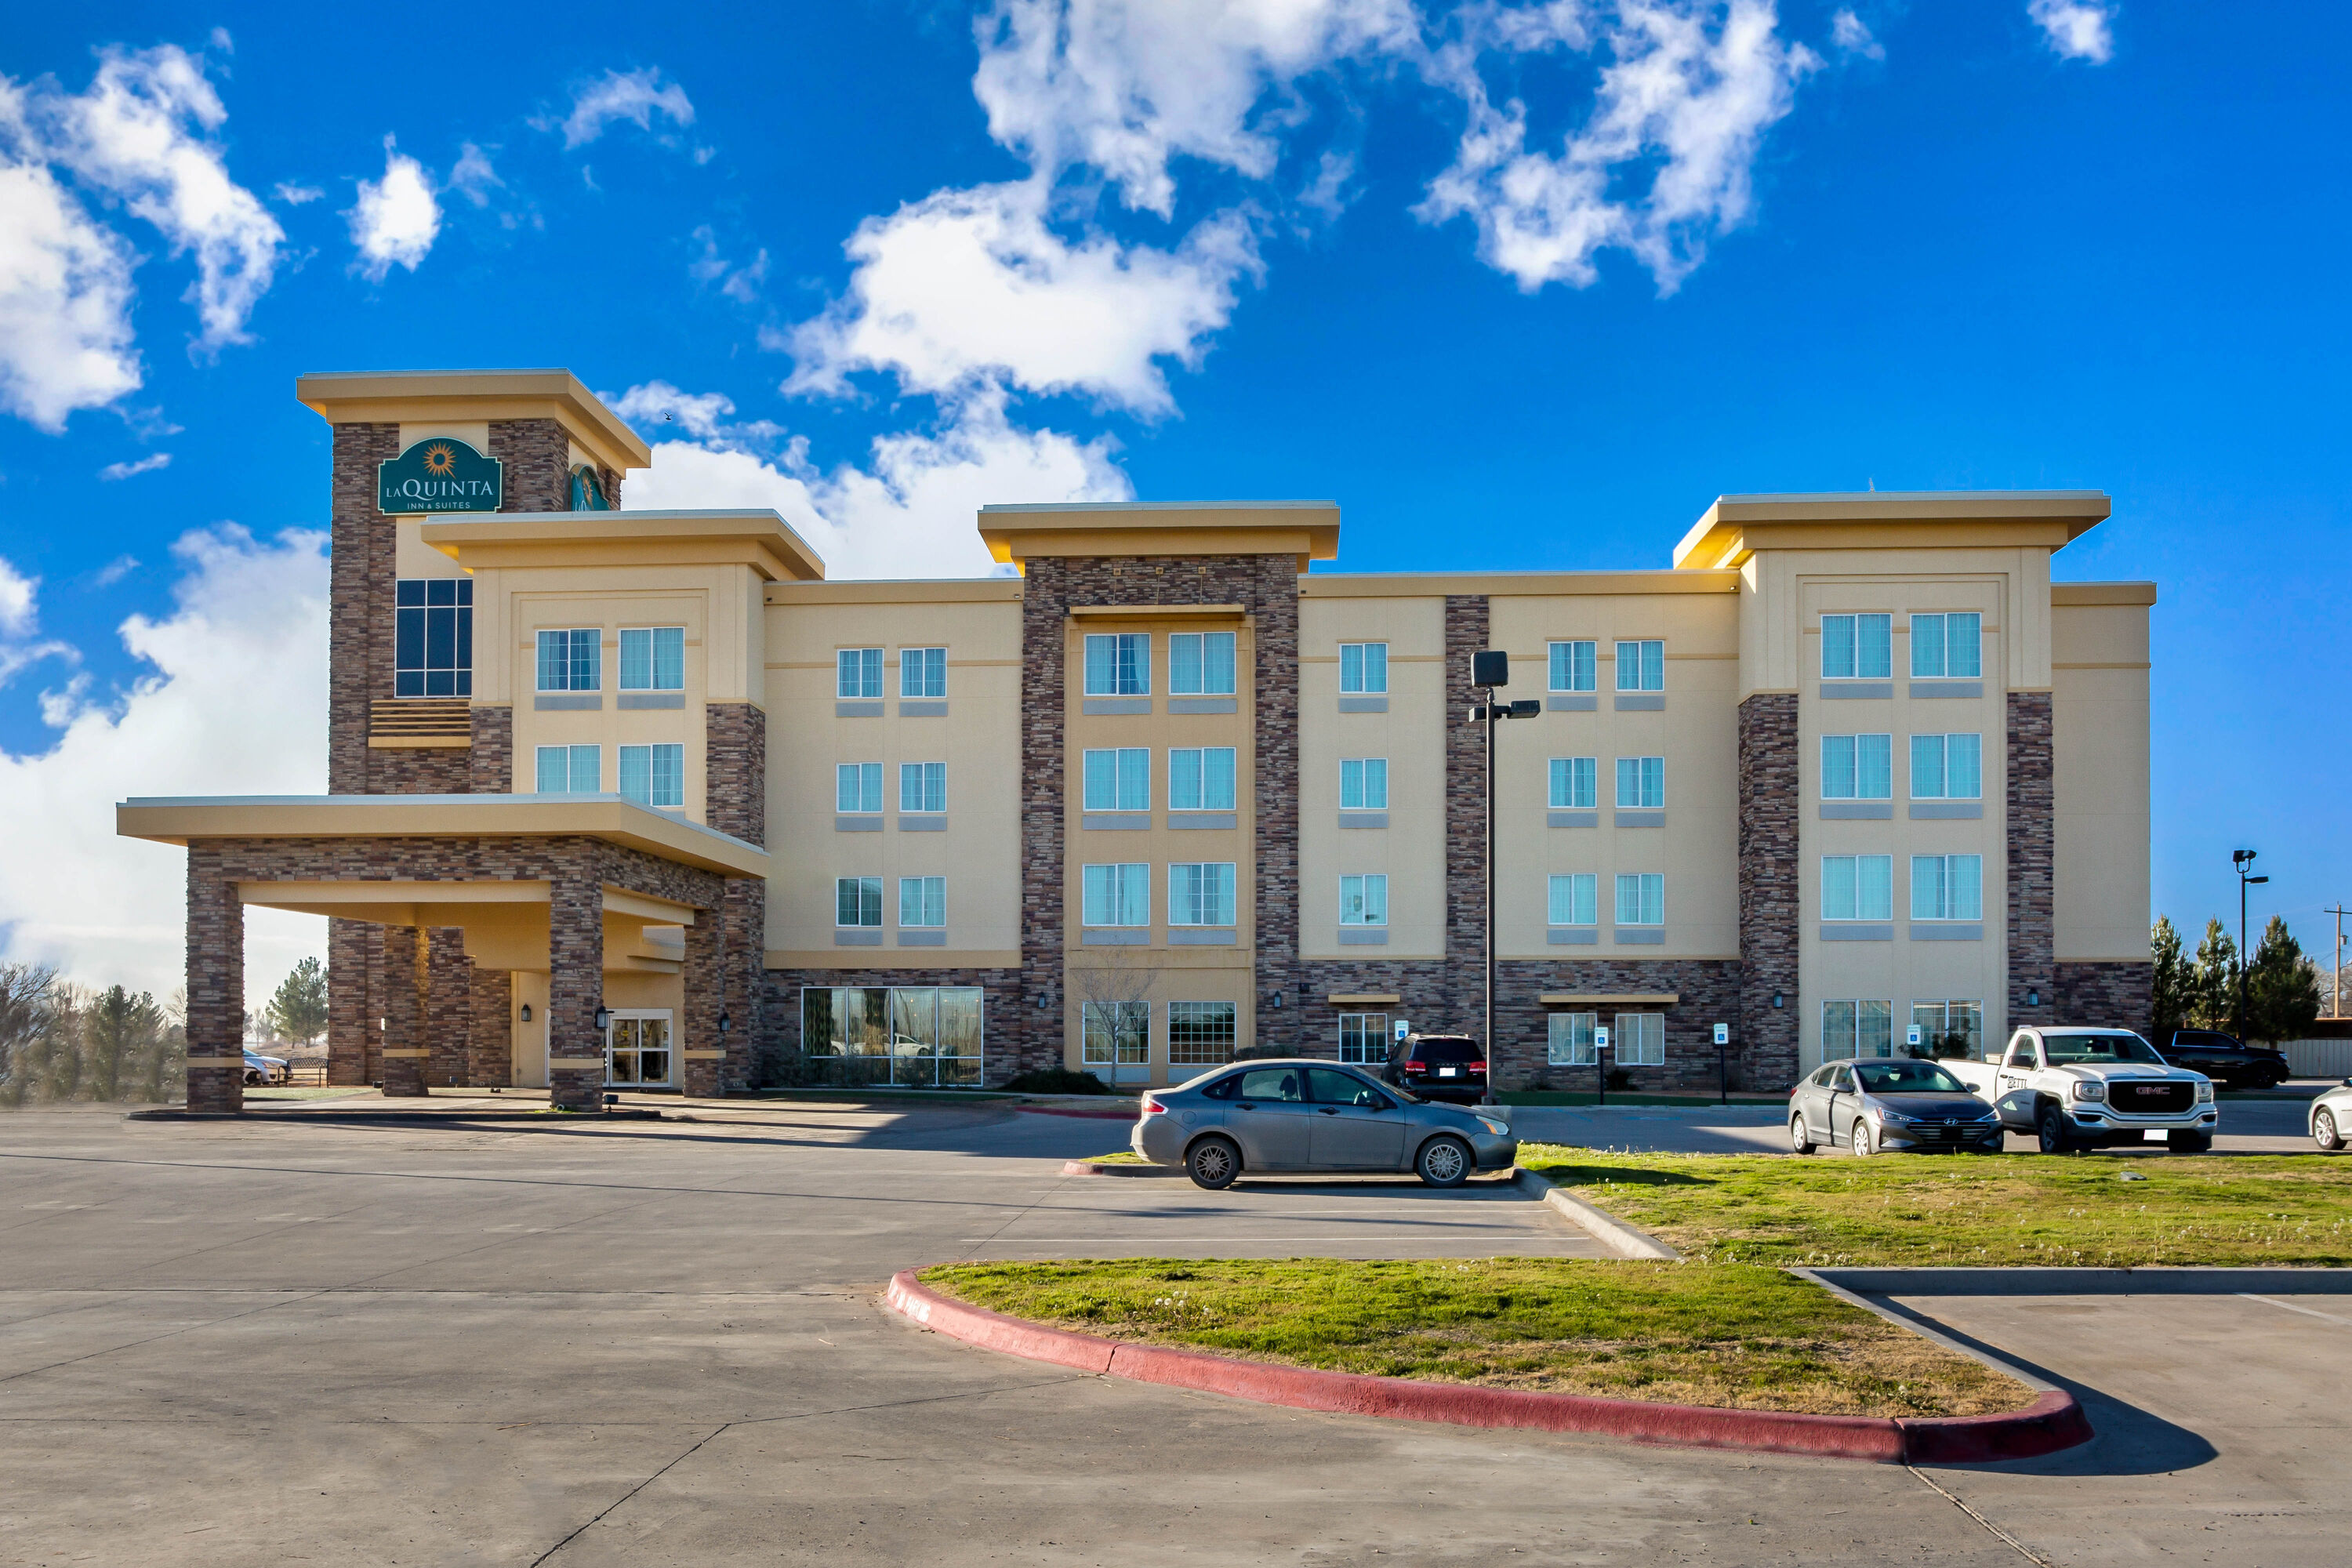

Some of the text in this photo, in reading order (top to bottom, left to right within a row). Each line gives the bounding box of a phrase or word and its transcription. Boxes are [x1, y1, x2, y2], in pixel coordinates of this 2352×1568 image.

[387, 478, 494, 501] LA QUINTA
[2136, 1087, 2170, 1095] GMC
